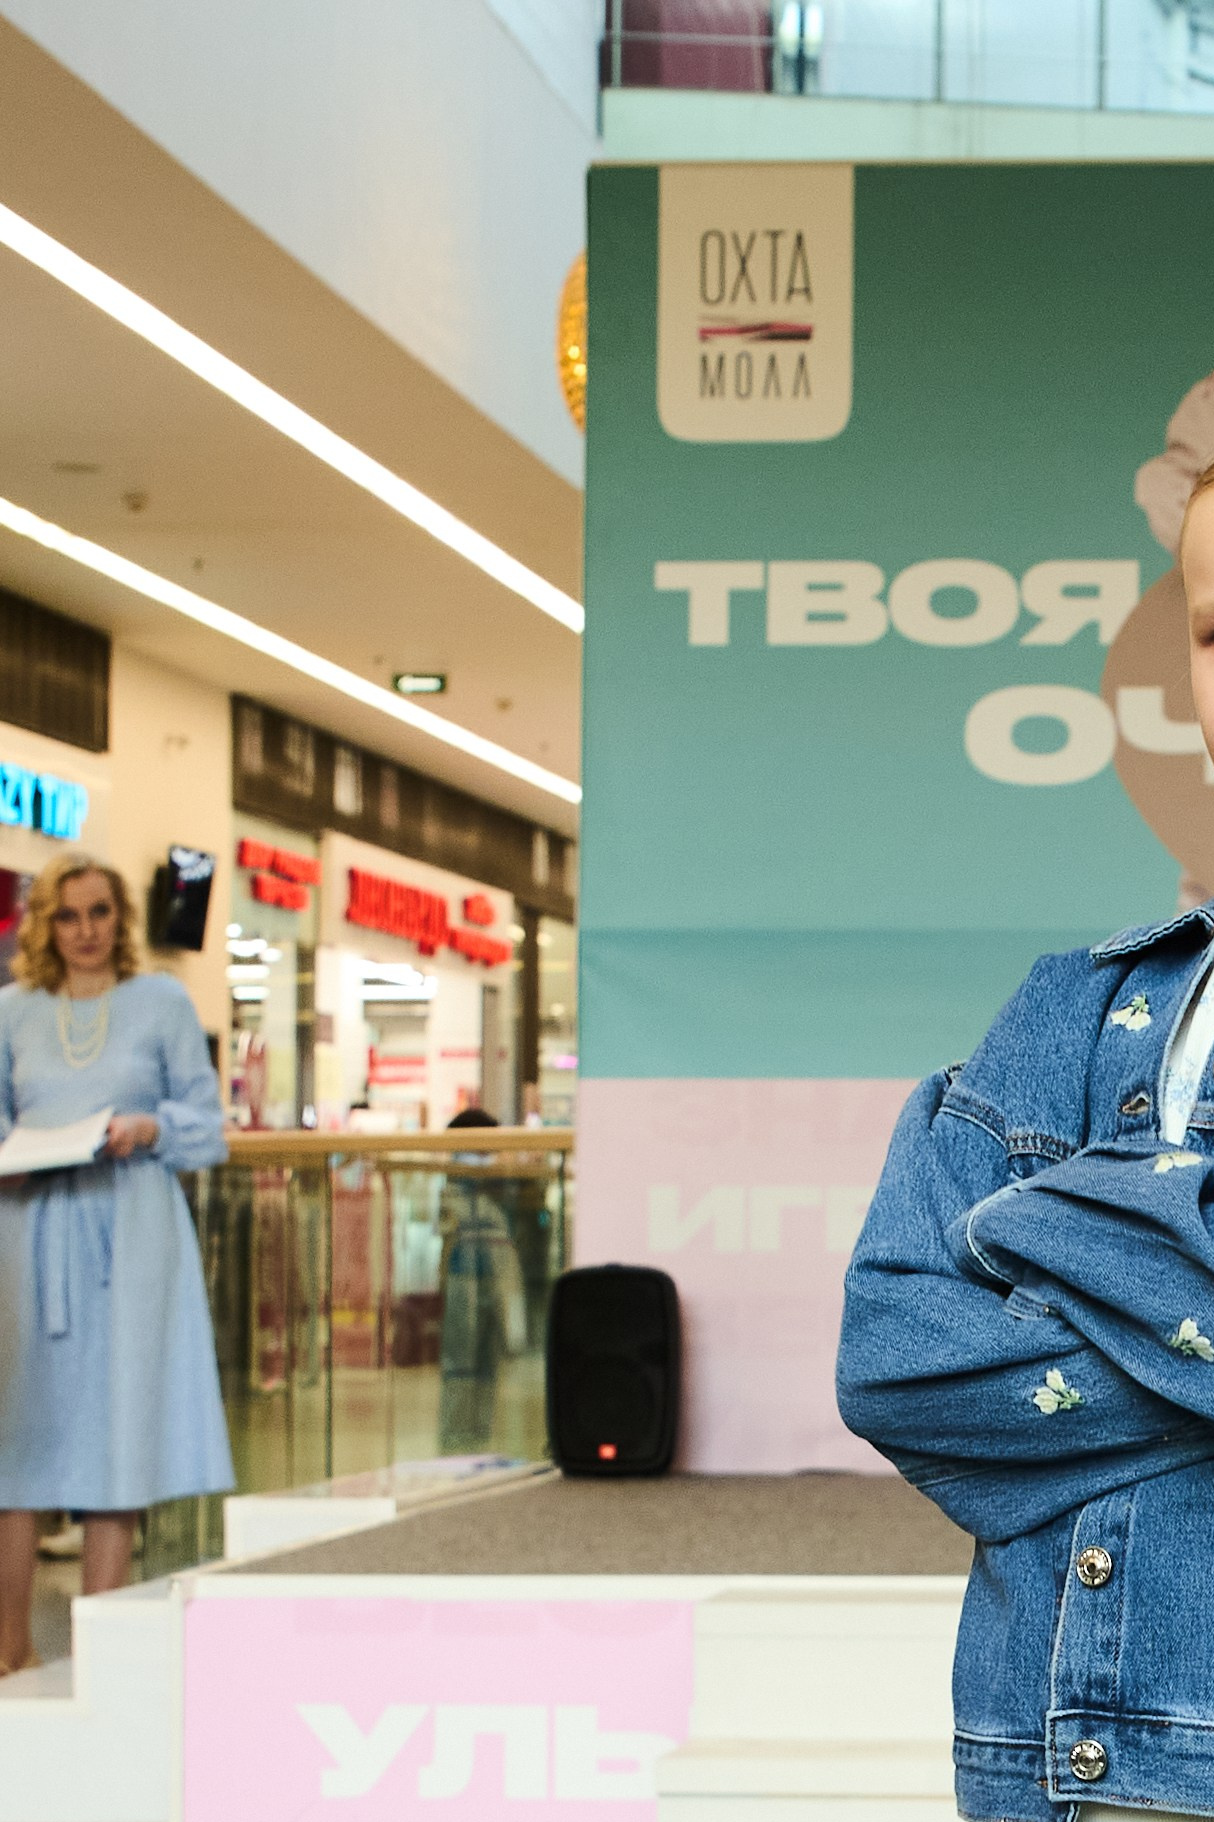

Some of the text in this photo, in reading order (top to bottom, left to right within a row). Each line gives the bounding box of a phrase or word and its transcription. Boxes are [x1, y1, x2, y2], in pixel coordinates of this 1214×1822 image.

[699, 228, 814, 305] ОХТА
[699, 351, 813, 400] МОЛЛ
[653, 558, 1141, 648] ТВОЯ
